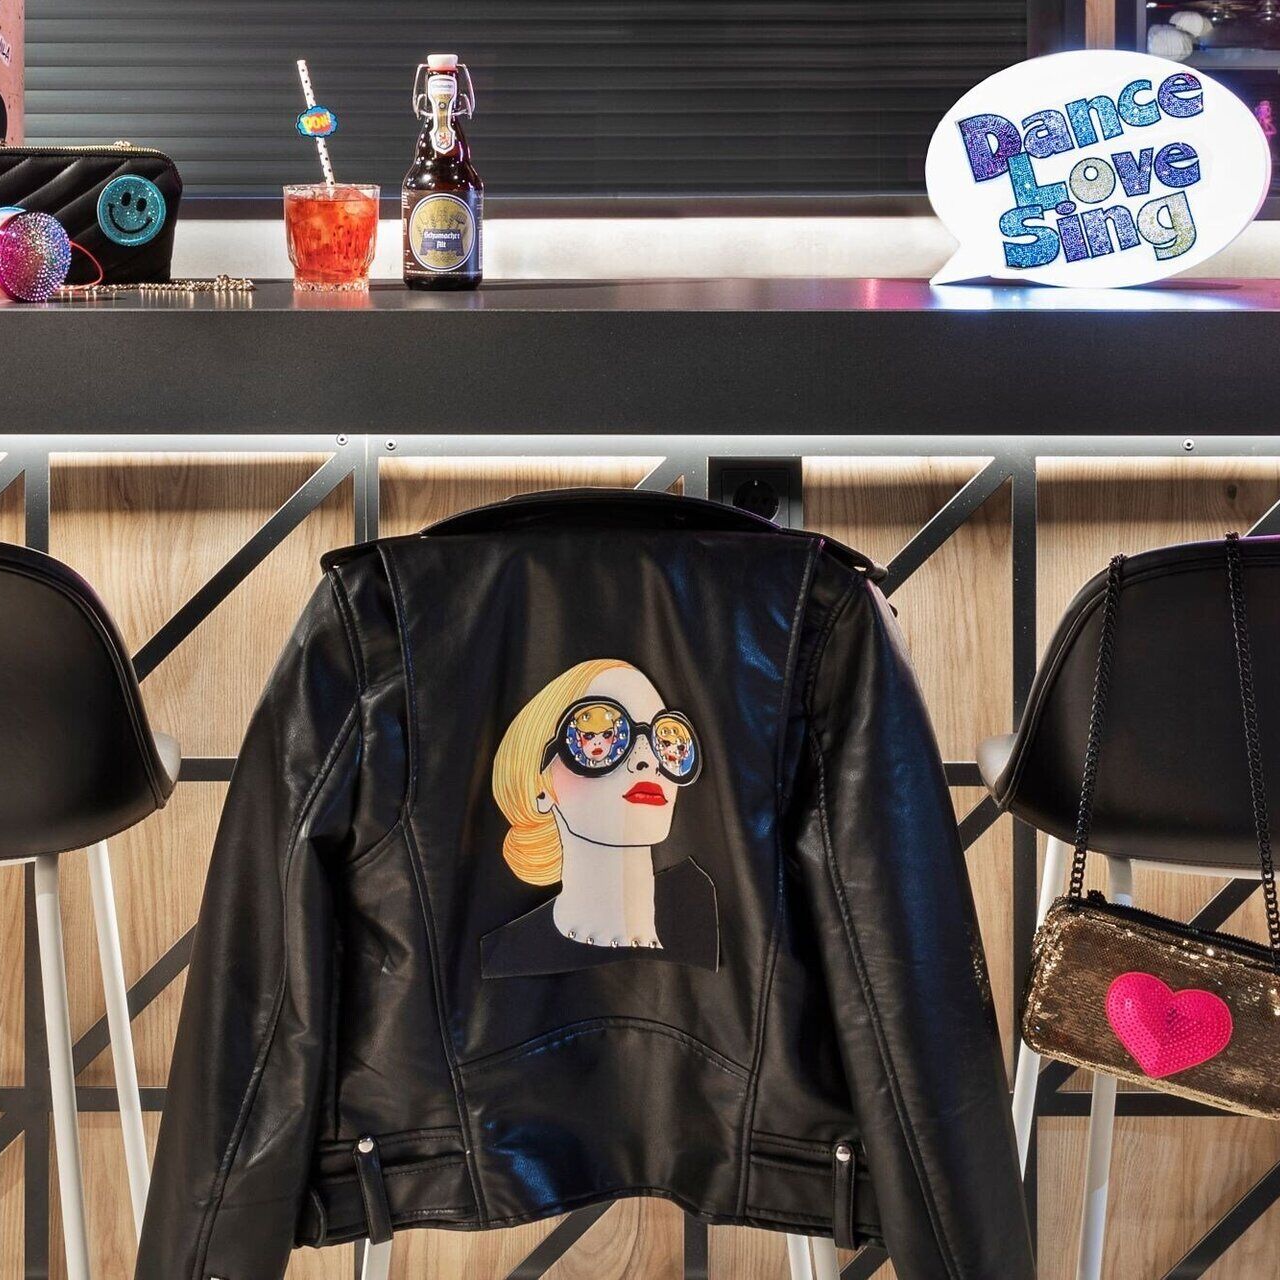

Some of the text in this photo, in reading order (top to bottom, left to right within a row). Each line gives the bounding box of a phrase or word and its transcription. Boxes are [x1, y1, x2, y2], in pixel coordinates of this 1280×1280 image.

[958, 72, 1204, 183] Dance
[1008, 142, 1201, 212] Love
[424, 230, 460, 240] Schumacher
[436, 240, 446, 249] Alt
[999, 191, 1197, 269] Sing
